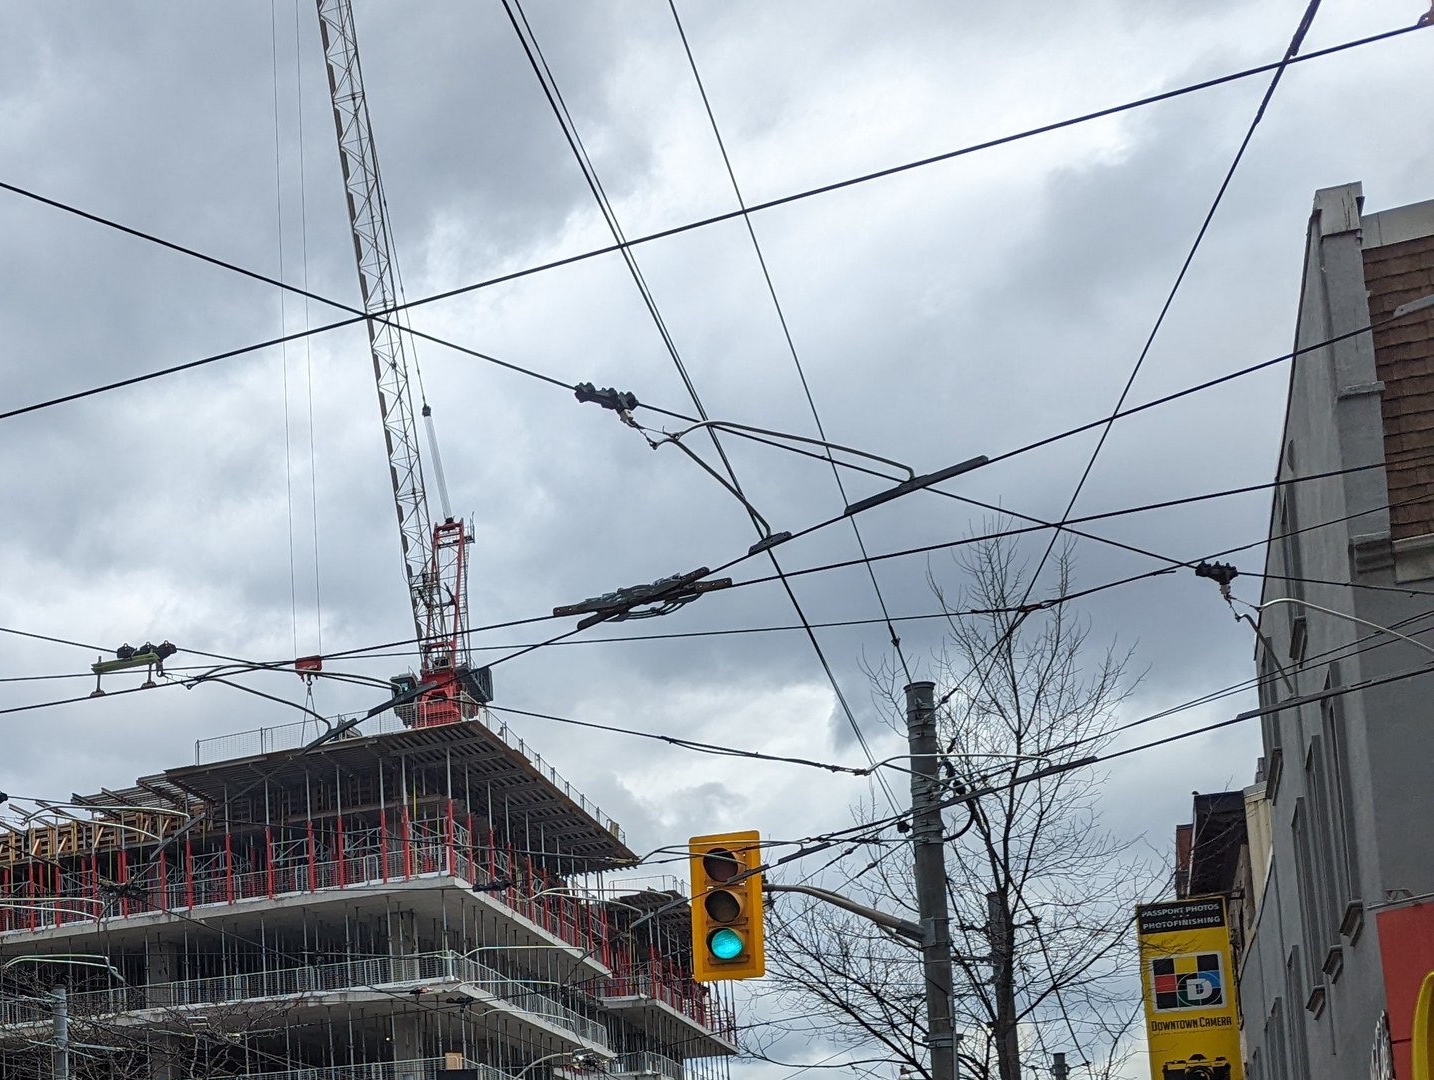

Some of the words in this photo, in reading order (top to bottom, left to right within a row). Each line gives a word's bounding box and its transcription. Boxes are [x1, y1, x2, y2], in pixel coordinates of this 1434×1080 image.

[1141, 906, 1183, 918] PASSPORT
[1185, 903, 1220, 913] PHOTOS
[1142, 915, 1221, 930] PHOTOFINISHING
[1151, 1019, 1198, 1032] DOWNTOWN
[1199, 1016, 1232, 1028] CAMERA
